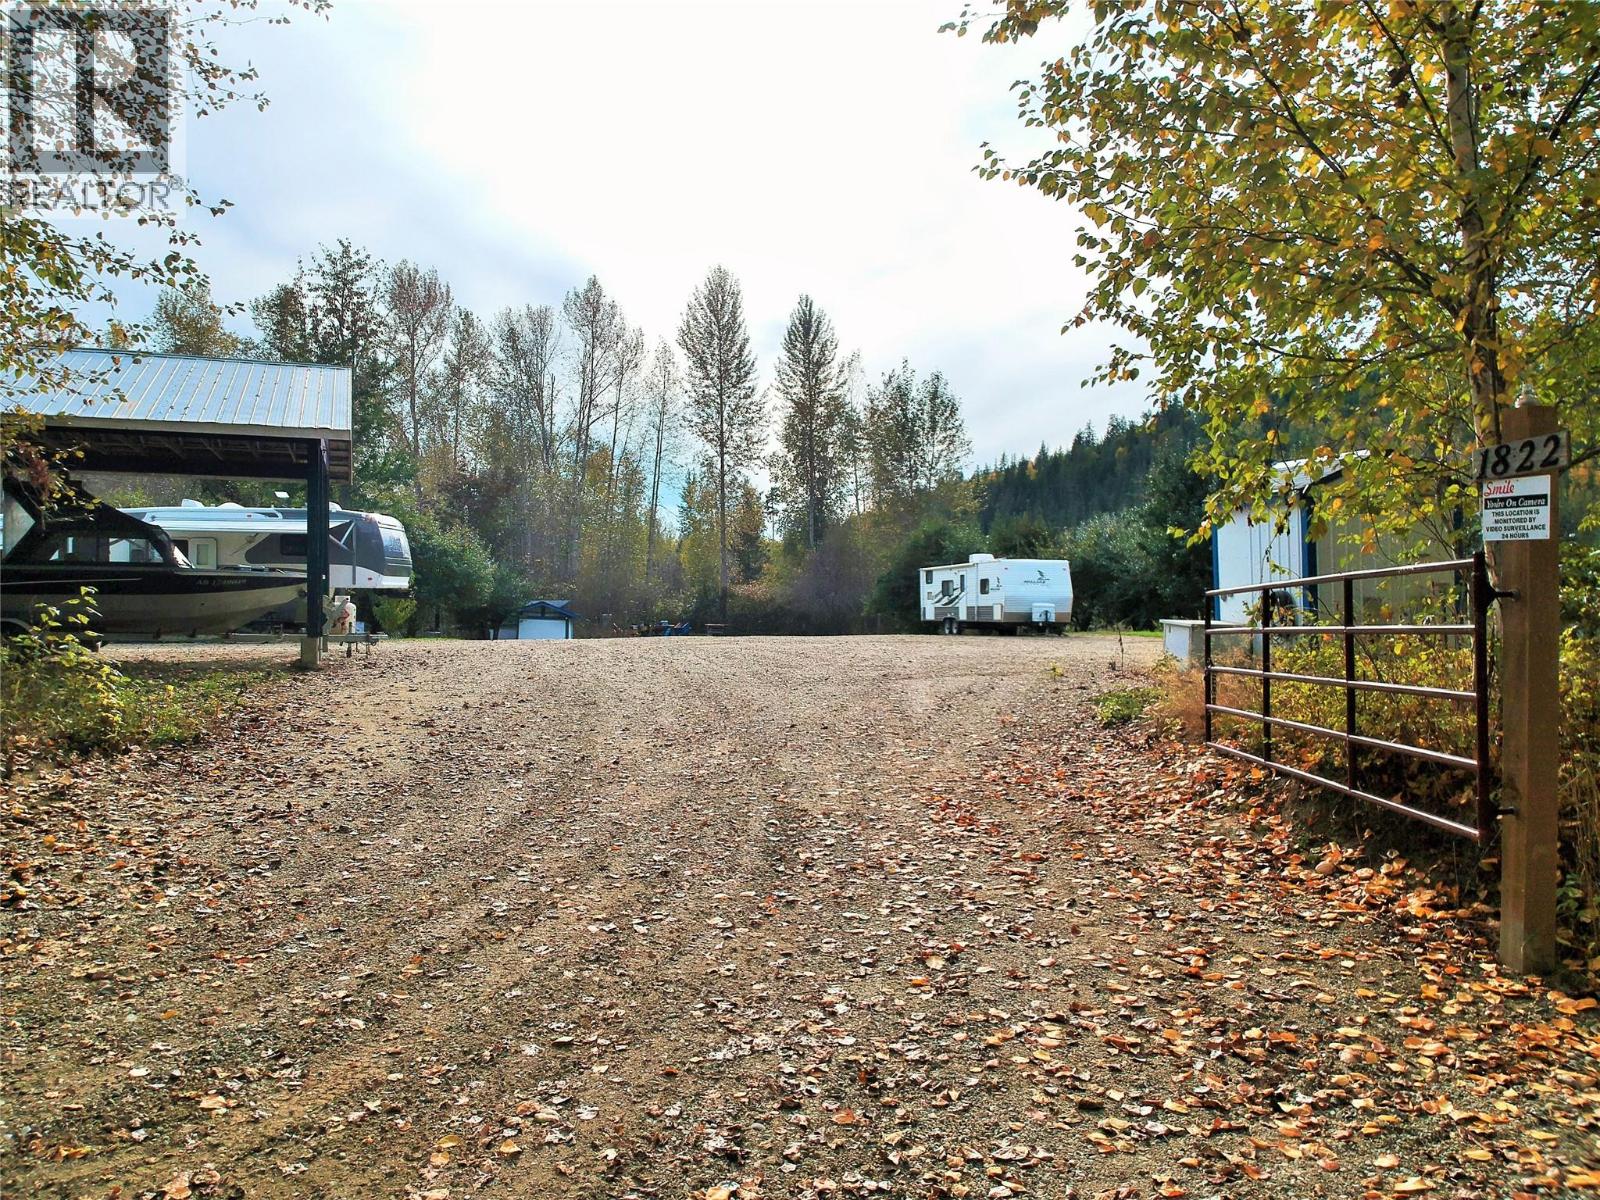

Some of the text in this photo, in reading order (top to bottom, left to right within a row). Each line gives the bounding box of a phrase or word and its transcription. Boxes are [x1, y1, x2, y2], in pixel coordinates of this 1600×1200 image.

[1477, 434, 1560, 480] 1822
[1484, 480, 1514, 496] Smile
[1506, 498, 1517, 507] On
[1518, 498, 1545, 506] Camera
